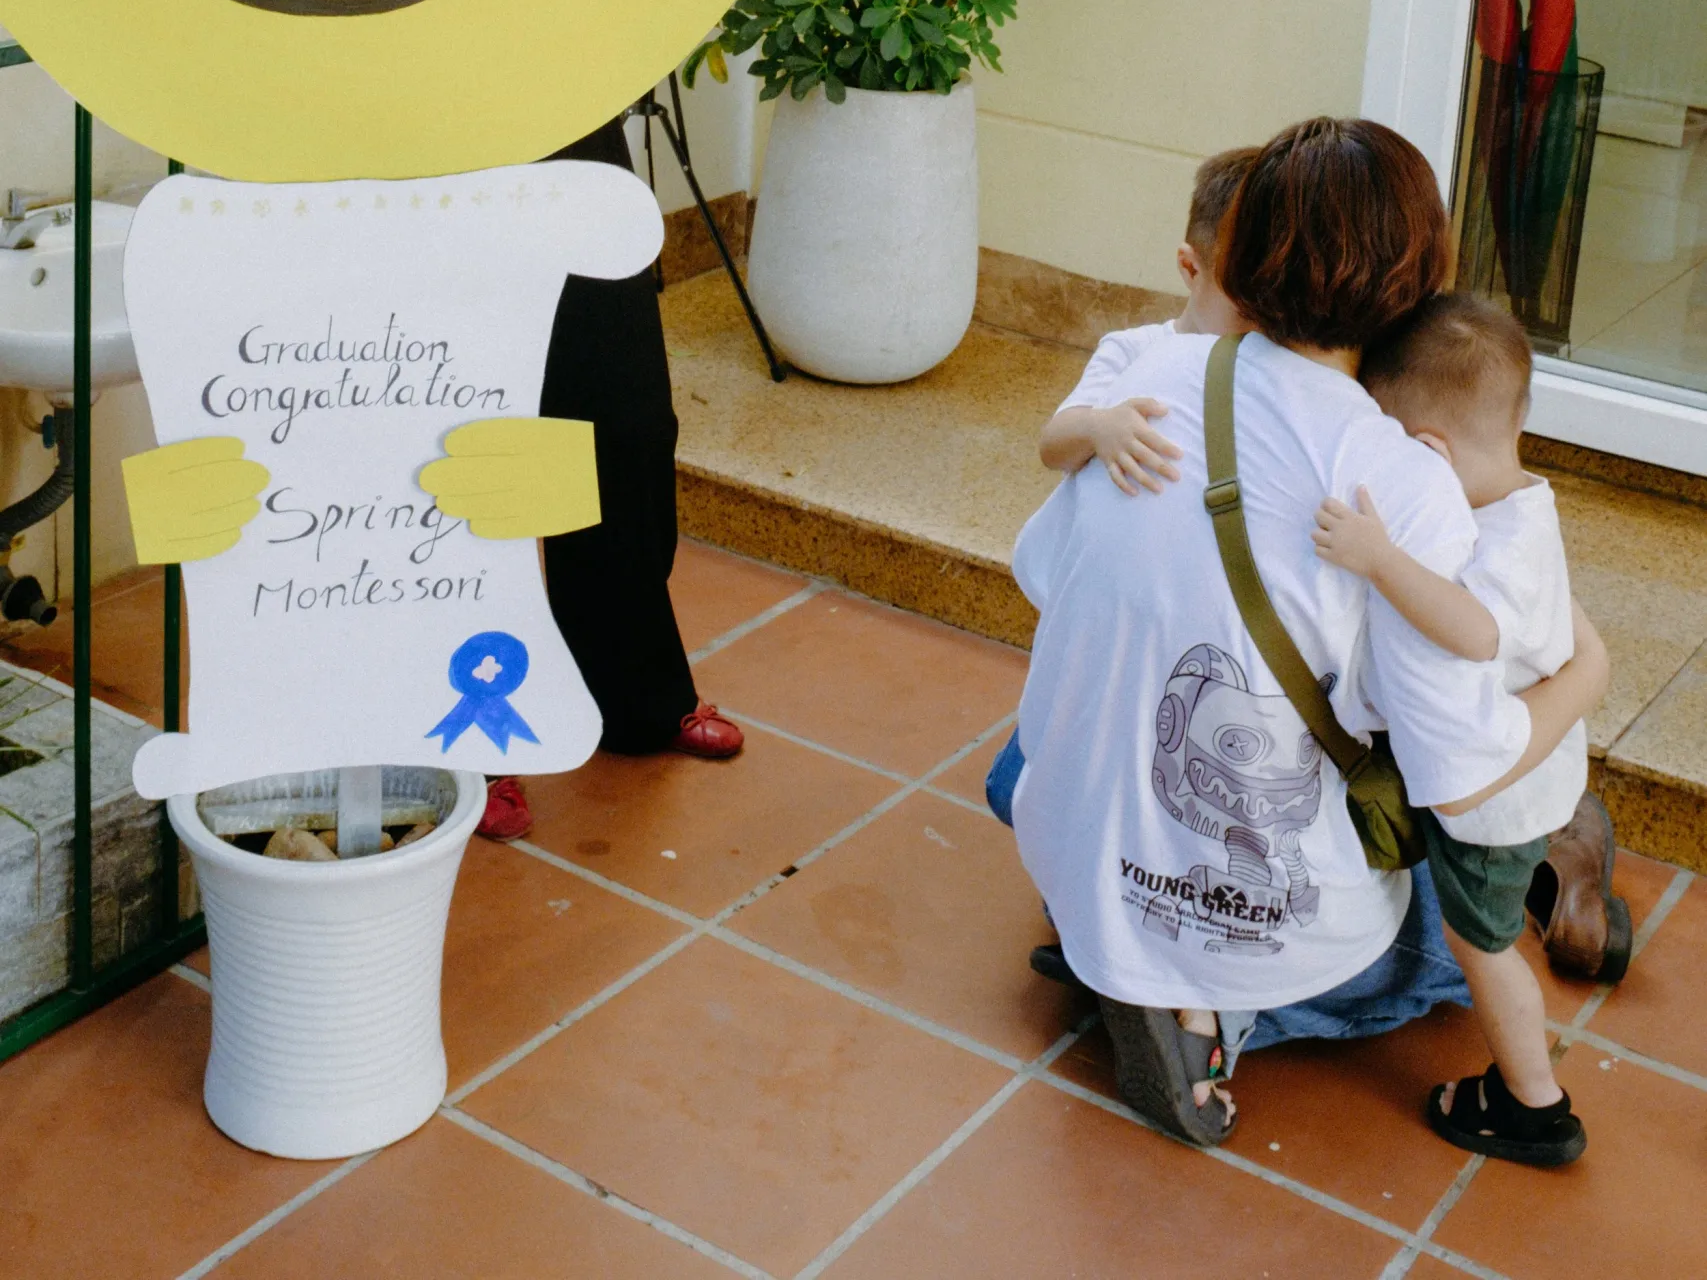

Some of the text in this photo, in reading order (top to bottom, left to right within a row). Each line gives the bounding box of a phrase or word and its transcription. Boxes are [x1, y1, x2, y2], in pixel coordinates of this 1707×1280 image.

[238, 312, 455, 366] Graduation
[201, 362, 511, 444] Congratulation
[265, 486, 463, 564] Spring
[253, 559, 487, 617] Montessori
[1120, 857, 1195, 901] YOUNG
[1201, 891, 1284, 923] GREEN
